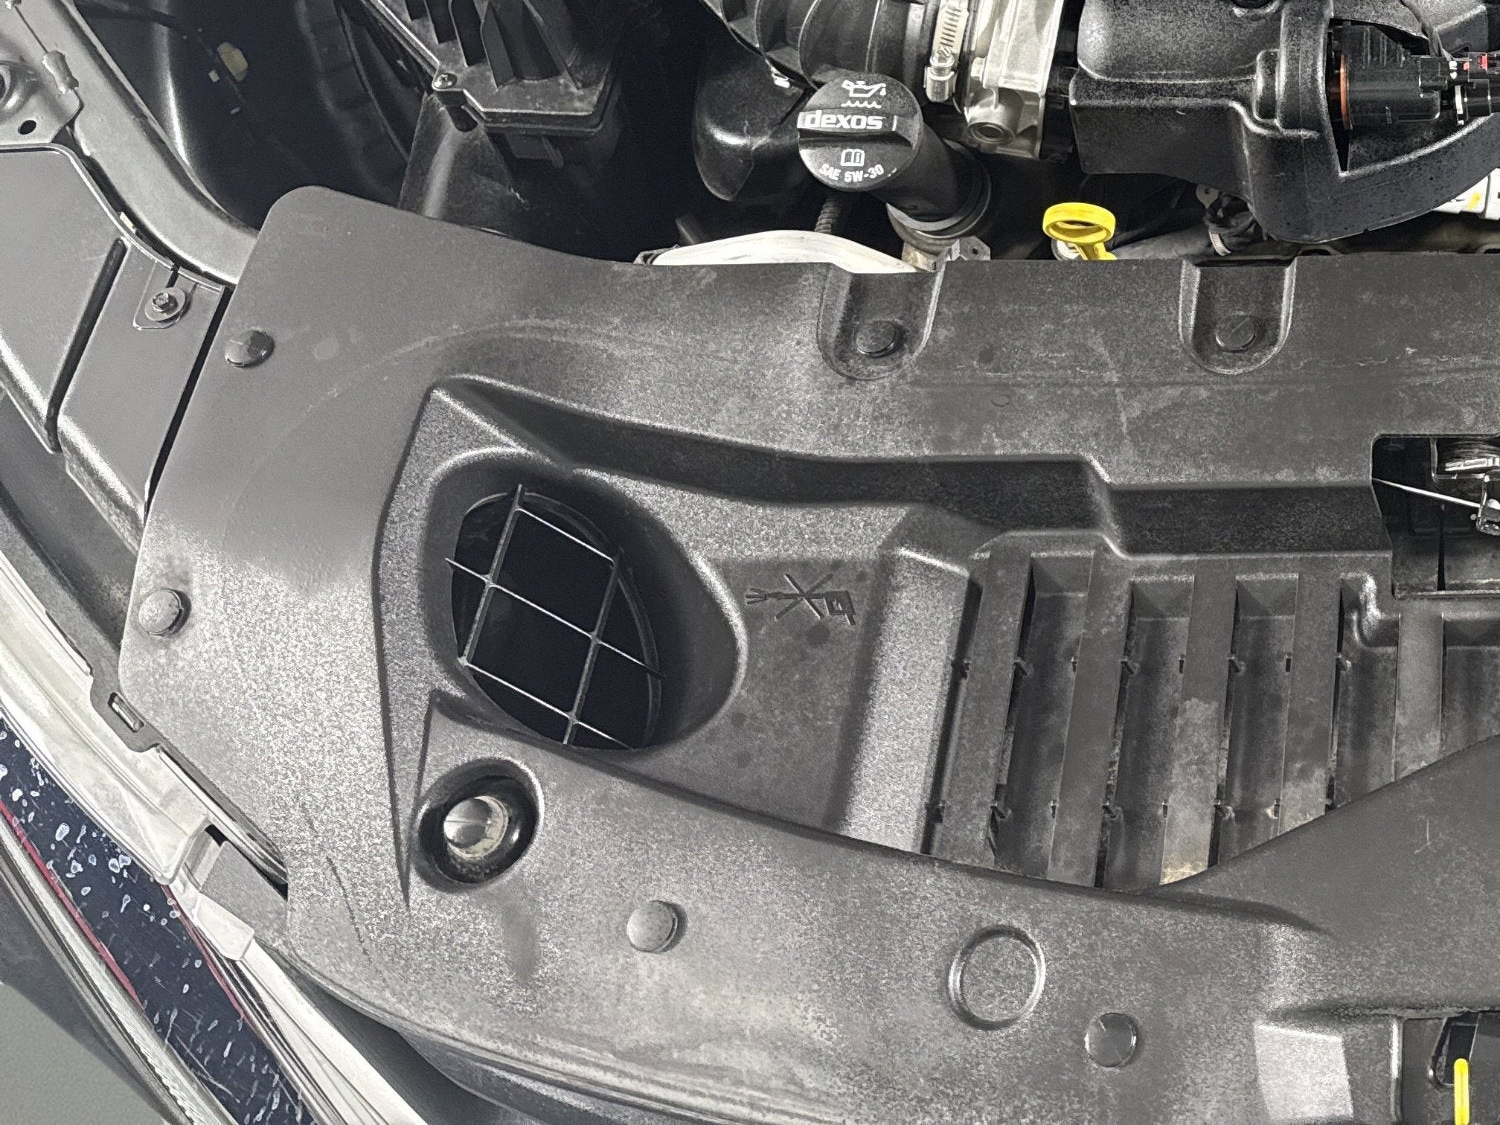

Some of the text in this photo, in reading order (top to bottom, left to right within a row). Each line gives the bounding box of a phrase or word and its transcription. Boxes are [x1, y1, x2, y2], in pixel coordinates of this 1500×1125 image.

[804, 110, 883, 129] dexos
[819, 164, 884, 182] SAE 5W-30
